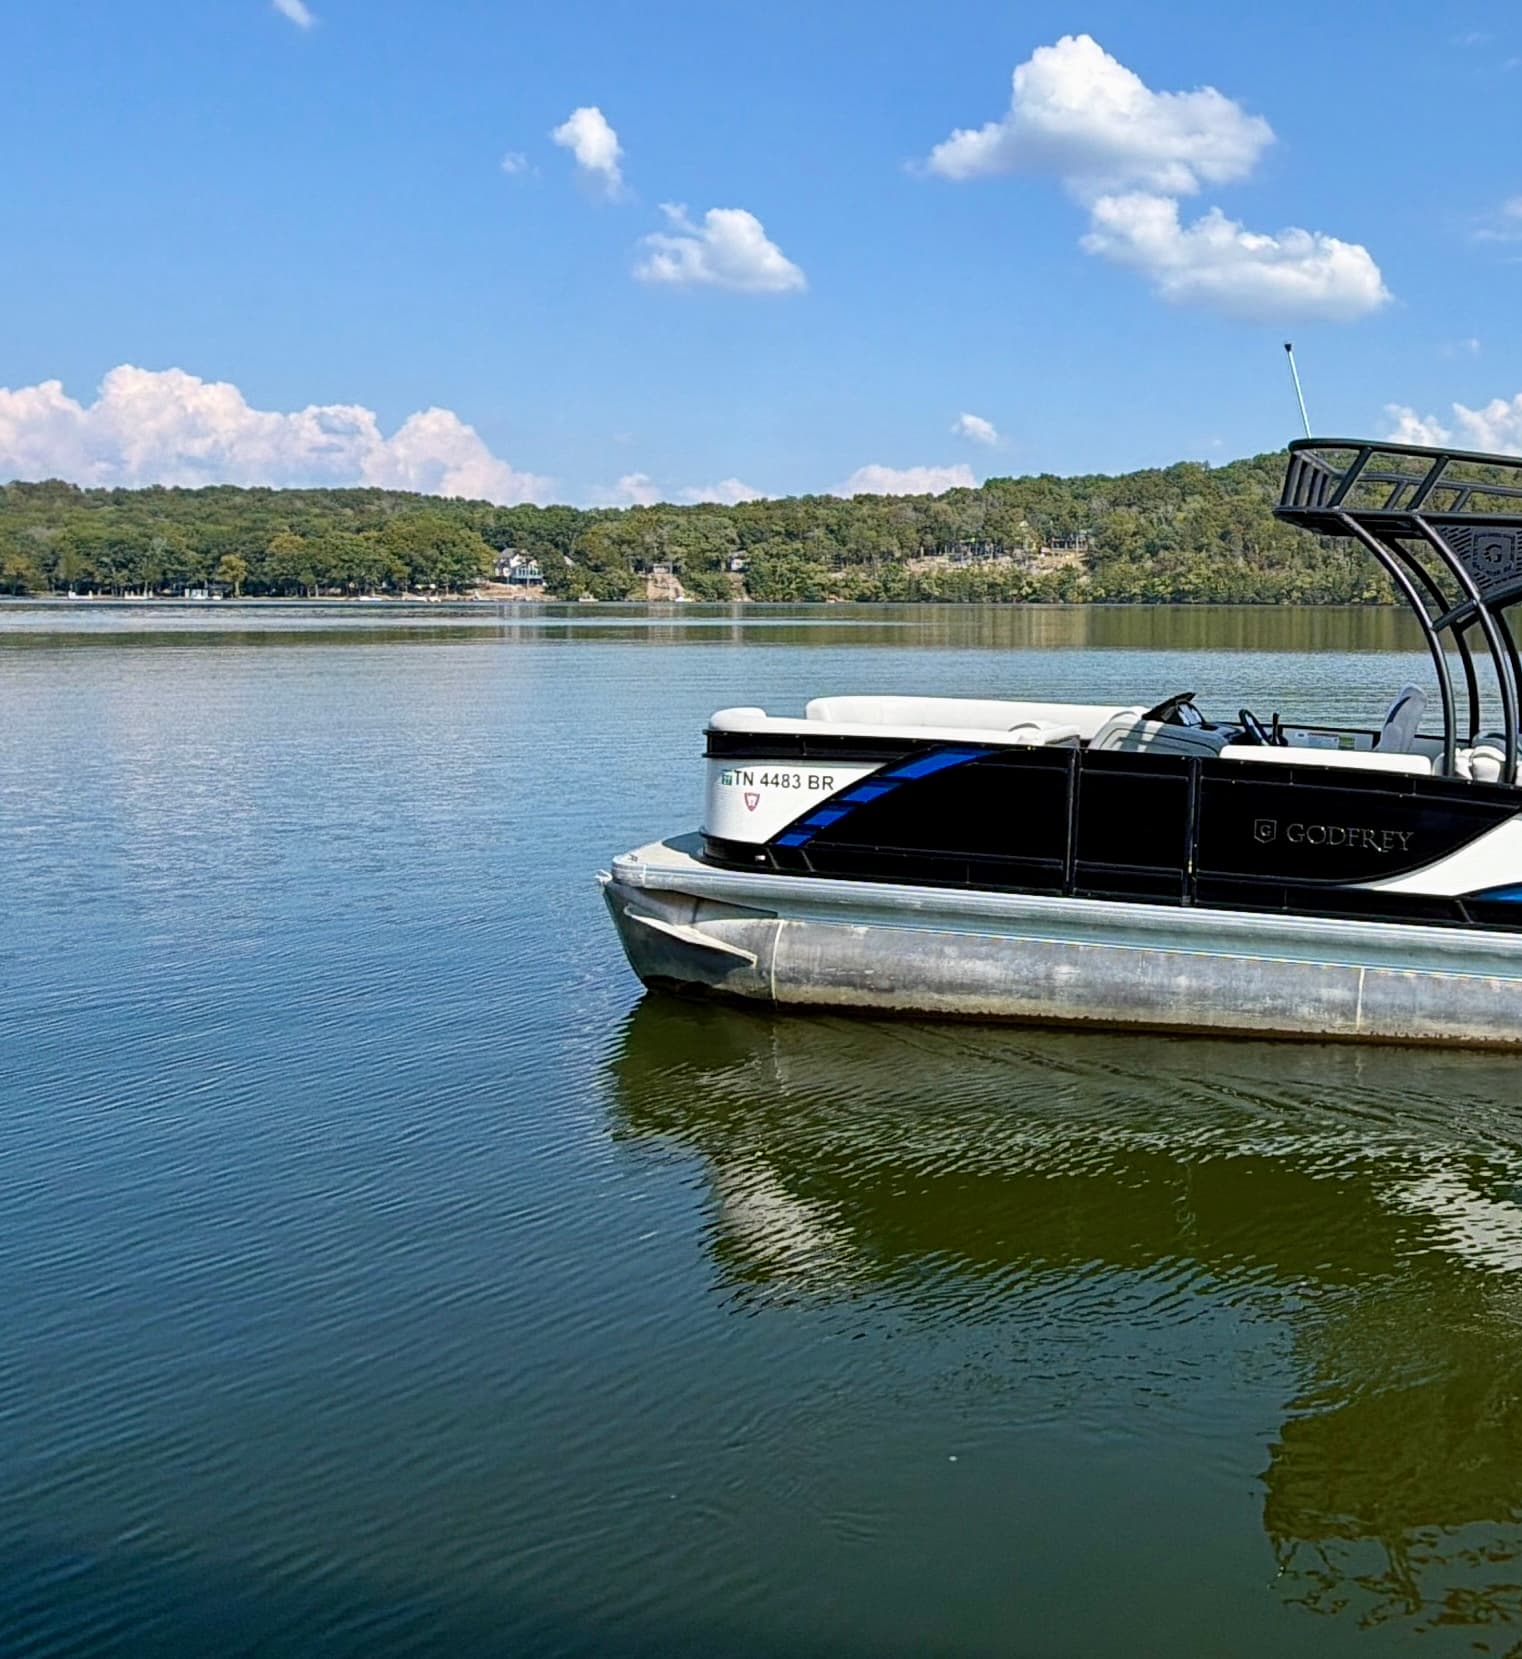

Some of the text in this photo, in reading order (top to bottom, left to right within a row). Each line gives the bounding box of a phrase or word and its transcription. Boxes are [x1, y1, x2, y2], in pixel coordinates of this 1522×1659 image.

[734, 769, 754, 786] TN
[760, 772, 802, 789] 4483
[808, 775, 834, 790] BR
[1286, 823, 1415, 853] GODFREY
